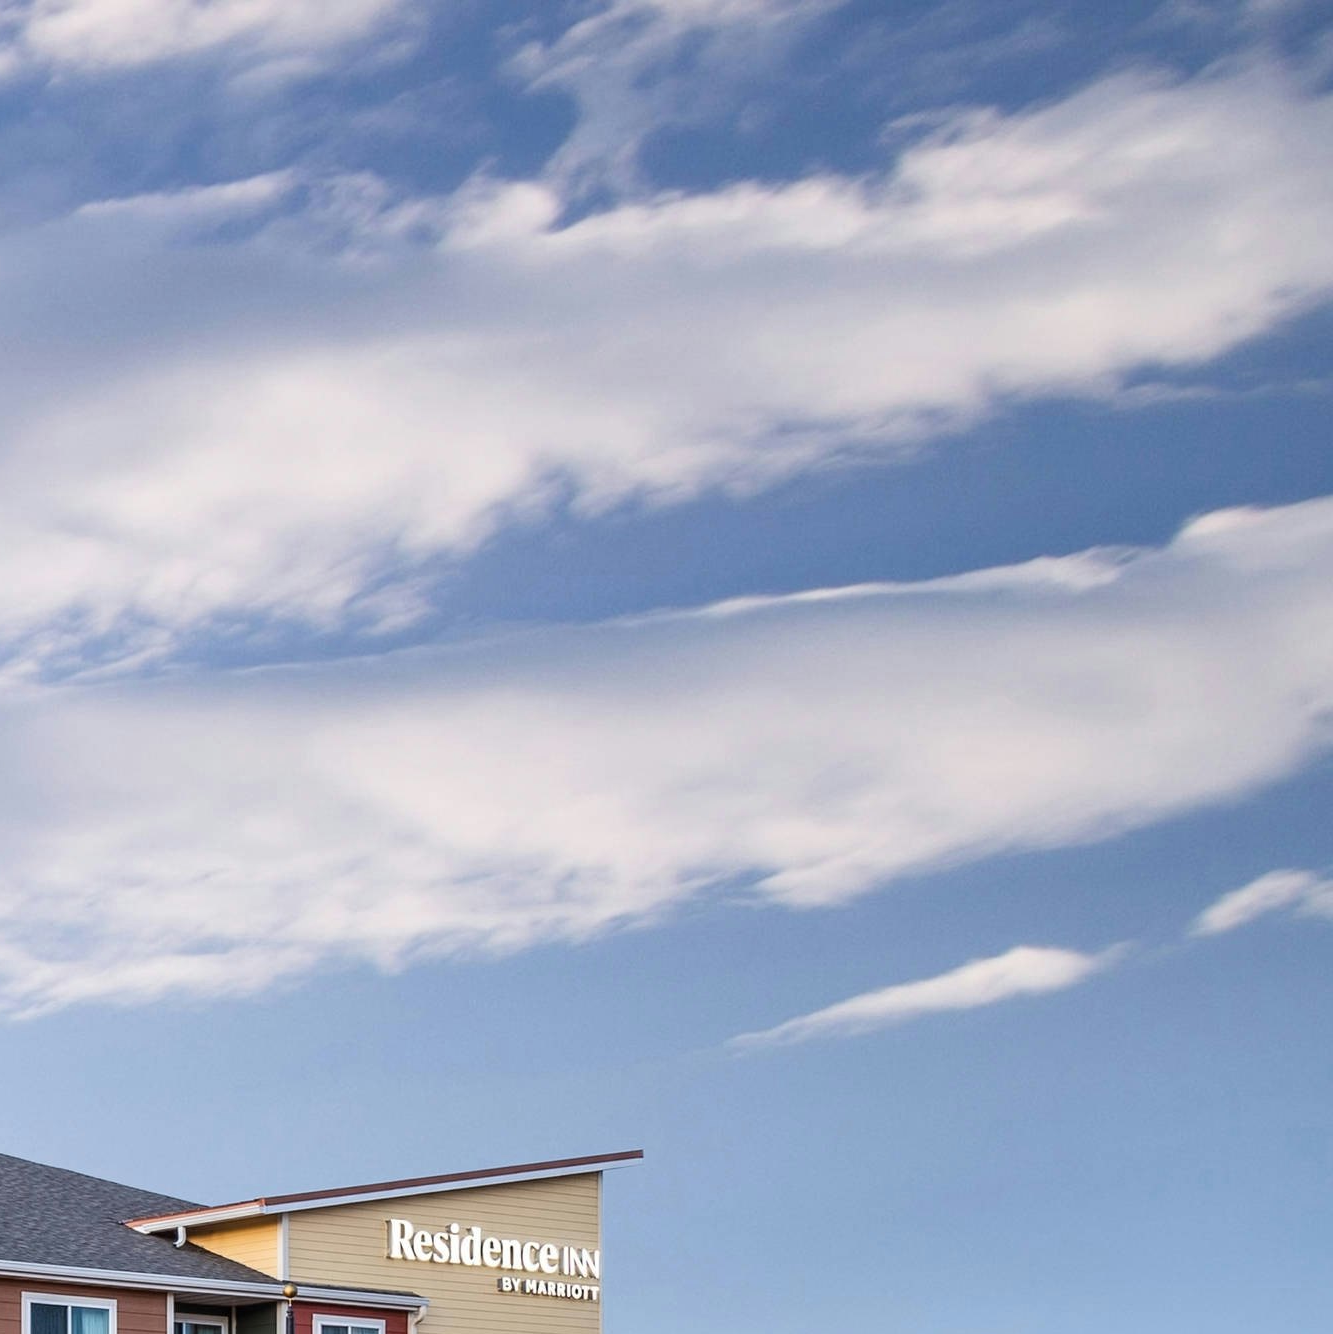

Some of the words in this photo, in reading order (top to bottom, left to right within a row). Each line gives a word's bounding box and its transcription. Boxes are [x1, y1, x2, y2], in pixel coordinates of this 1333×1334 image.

[389, 1218, 559, 1275] Residence
[561, 1246, 600, 1280] INN
[501, 1276, 522, 1293] BY
[525, 1279, 600, 1301] MARRIOTT
